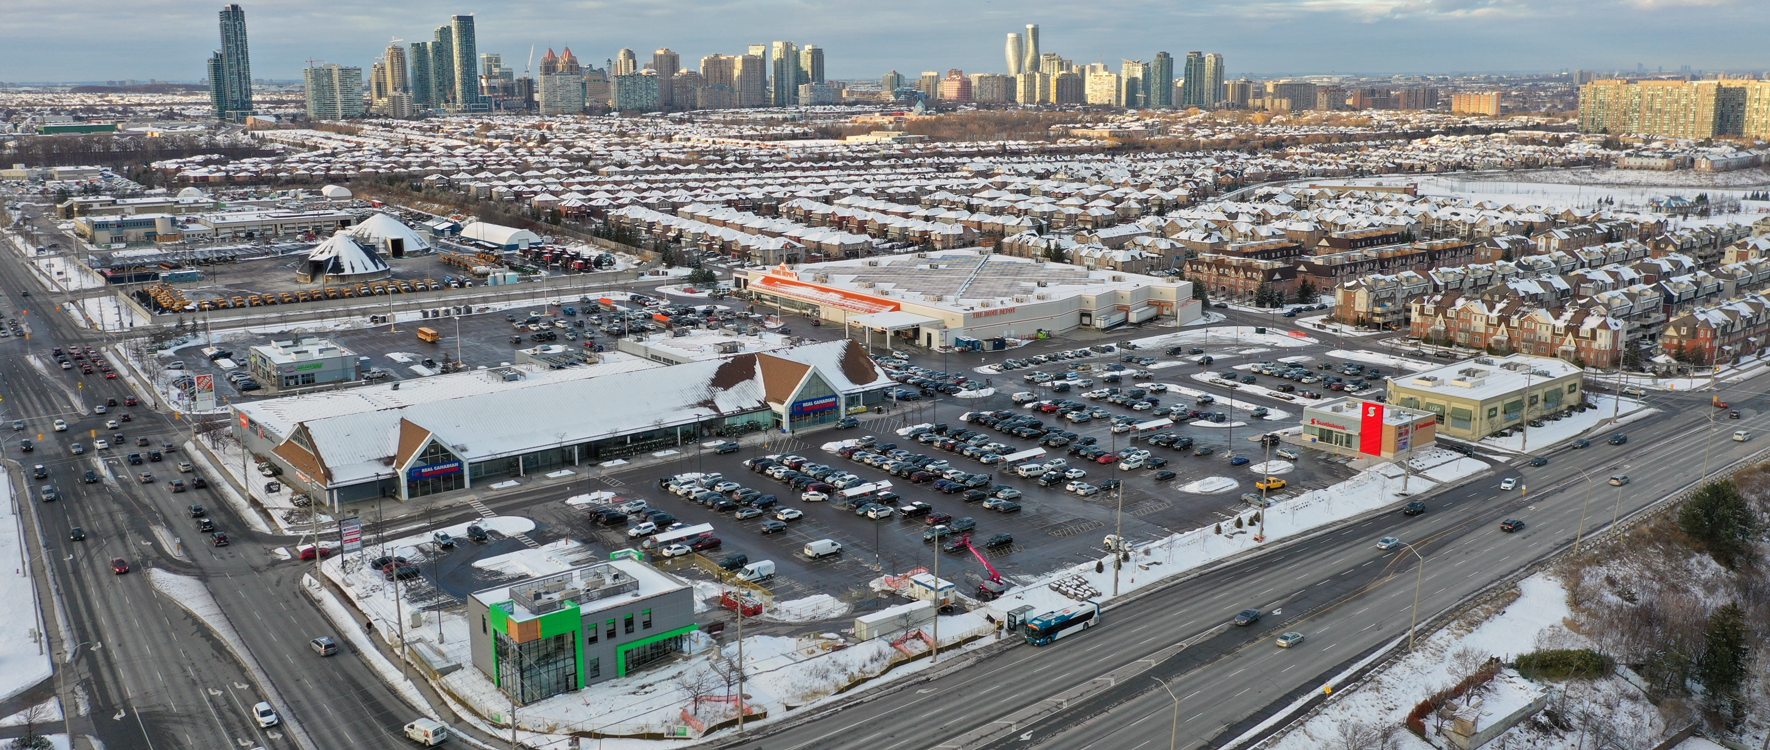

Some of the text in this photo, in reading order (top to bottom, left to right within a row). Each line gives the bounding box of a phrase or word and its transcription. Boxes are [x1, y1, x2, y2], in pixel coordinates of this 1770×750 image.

[984, 309, 998, 317] HOME
[1000, 307, 1016, 315] DEPOT
[814, 397, 836, 405] CANADIAN
[803, 401, 836, 412] SUPERSTORE
[1316, 420, 1346, 430] Scotiabank
[434, 462, 459, 471] CANADIAN
[422, 467, 459, 477] SUPERSTORE
